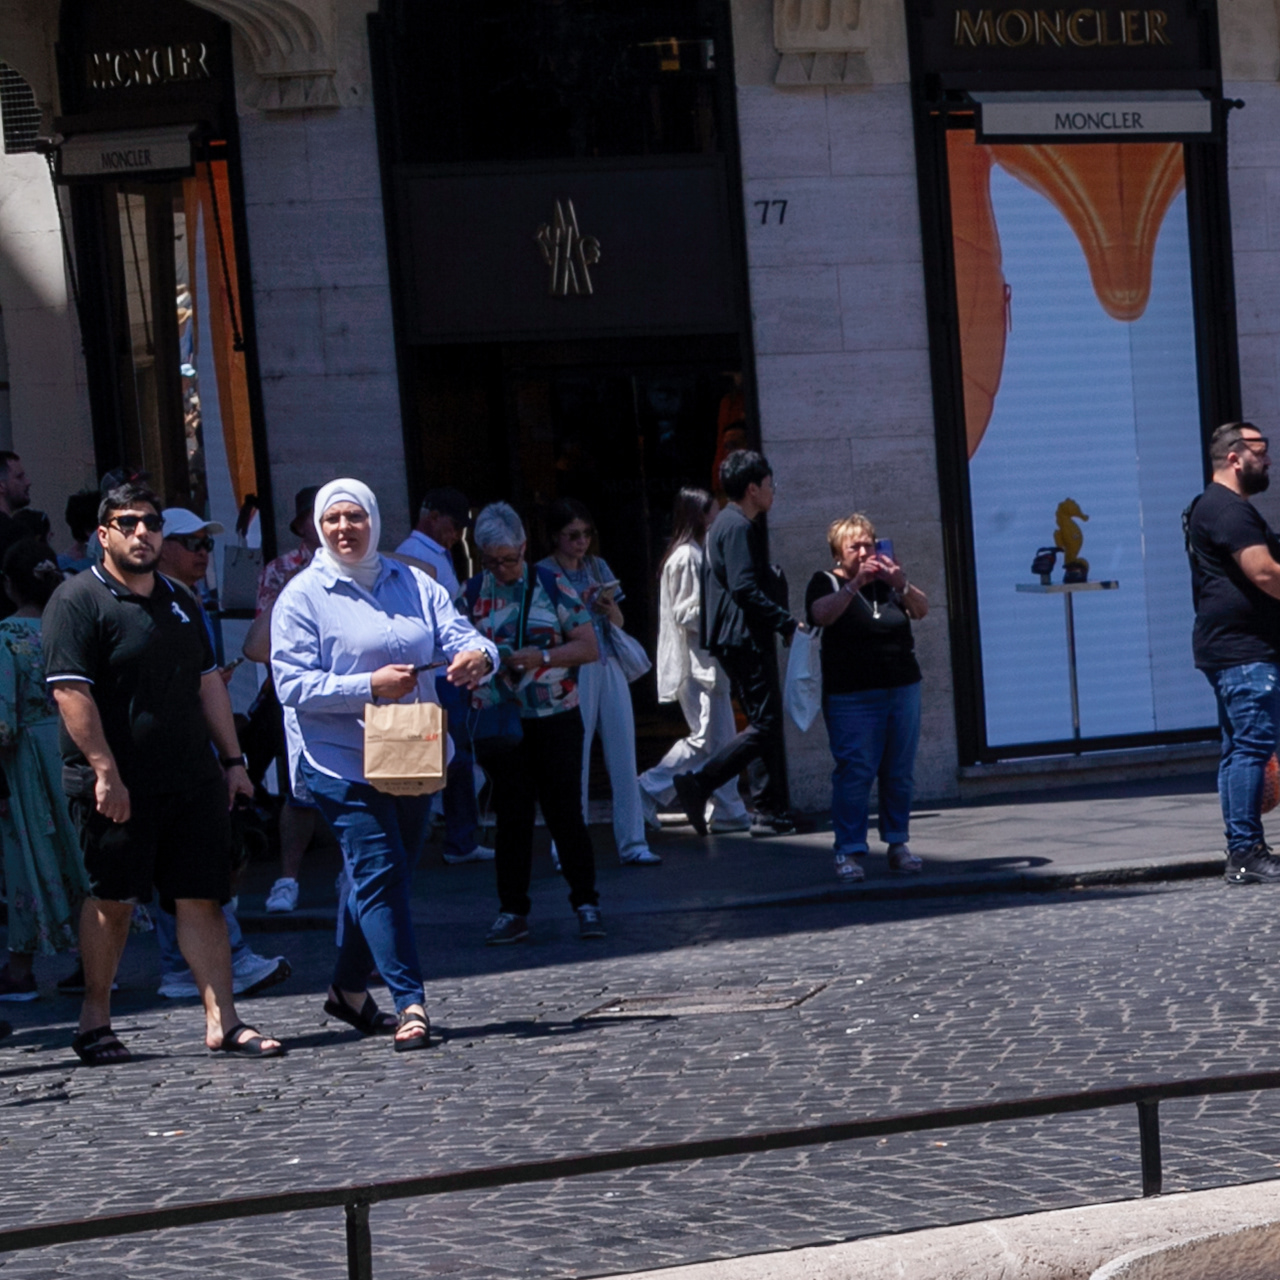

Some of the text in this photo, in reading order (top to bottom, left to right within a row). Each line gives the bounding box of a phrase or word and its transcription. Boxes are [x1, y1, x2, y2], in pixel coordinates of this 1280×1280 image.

[954, 9, 1172, 47] MONCLER
[88, 42, 209, 88] MONCLER
[1054, 112, 1144, 130] MONCLER
[101, 149, 152, 169] MONCLER
[754, 200, 788, 225] 77
